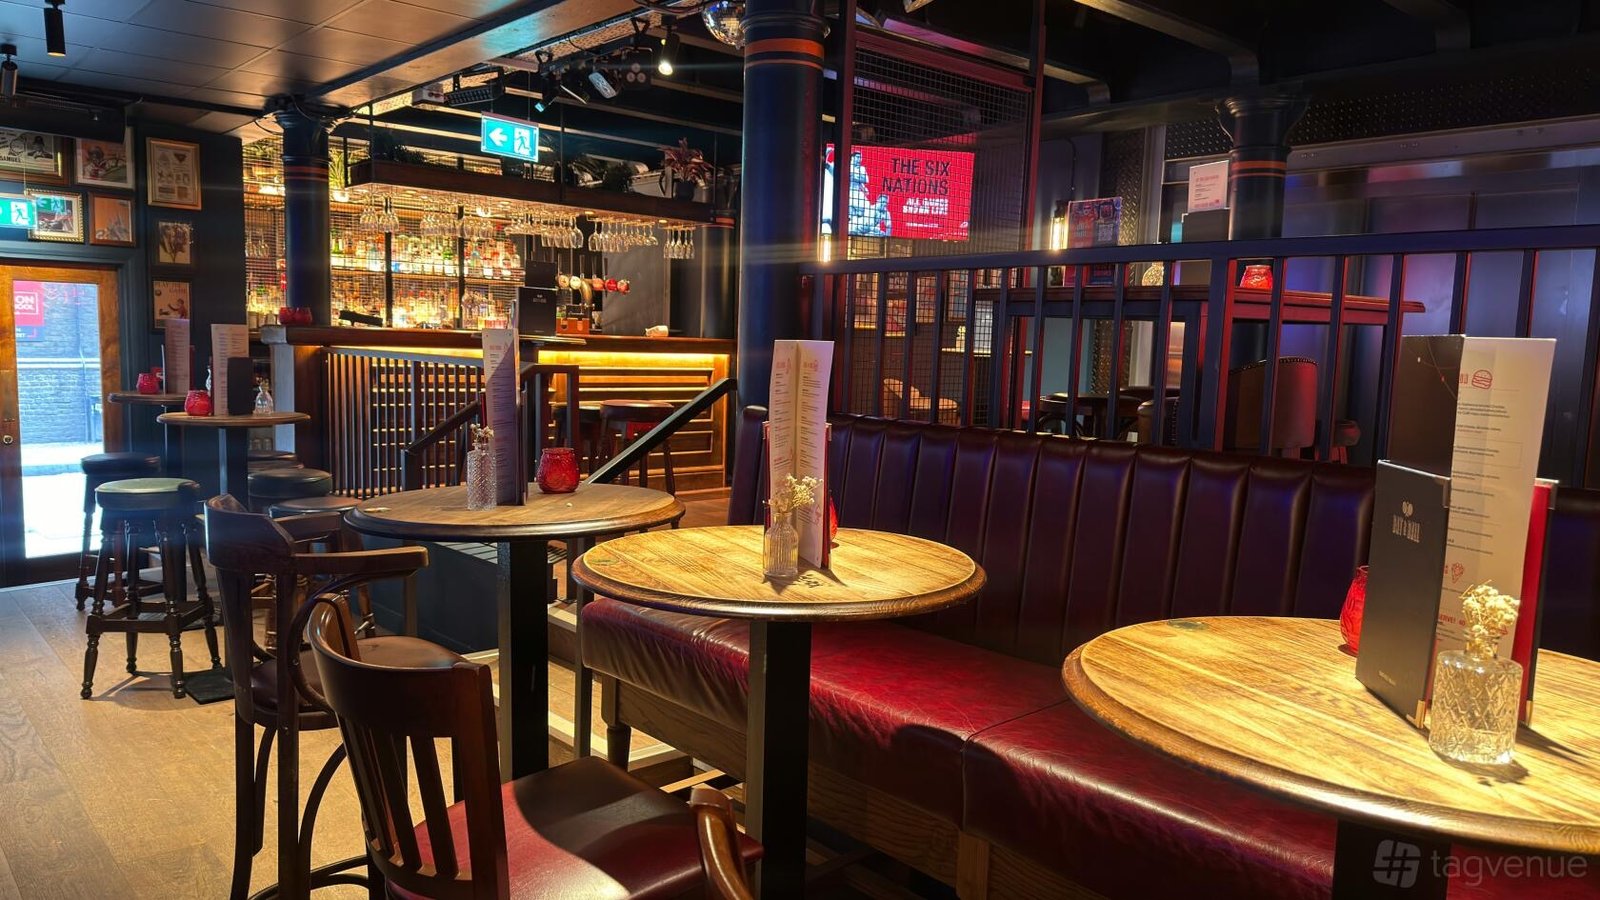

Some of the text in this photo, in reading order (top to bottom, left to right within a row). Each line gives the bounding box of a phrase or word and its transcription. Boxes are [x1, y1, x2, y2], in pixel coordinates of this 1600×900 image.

[891, 158, 950, 176] THE SIX
[882, 176, 949, 195] NATIONS
